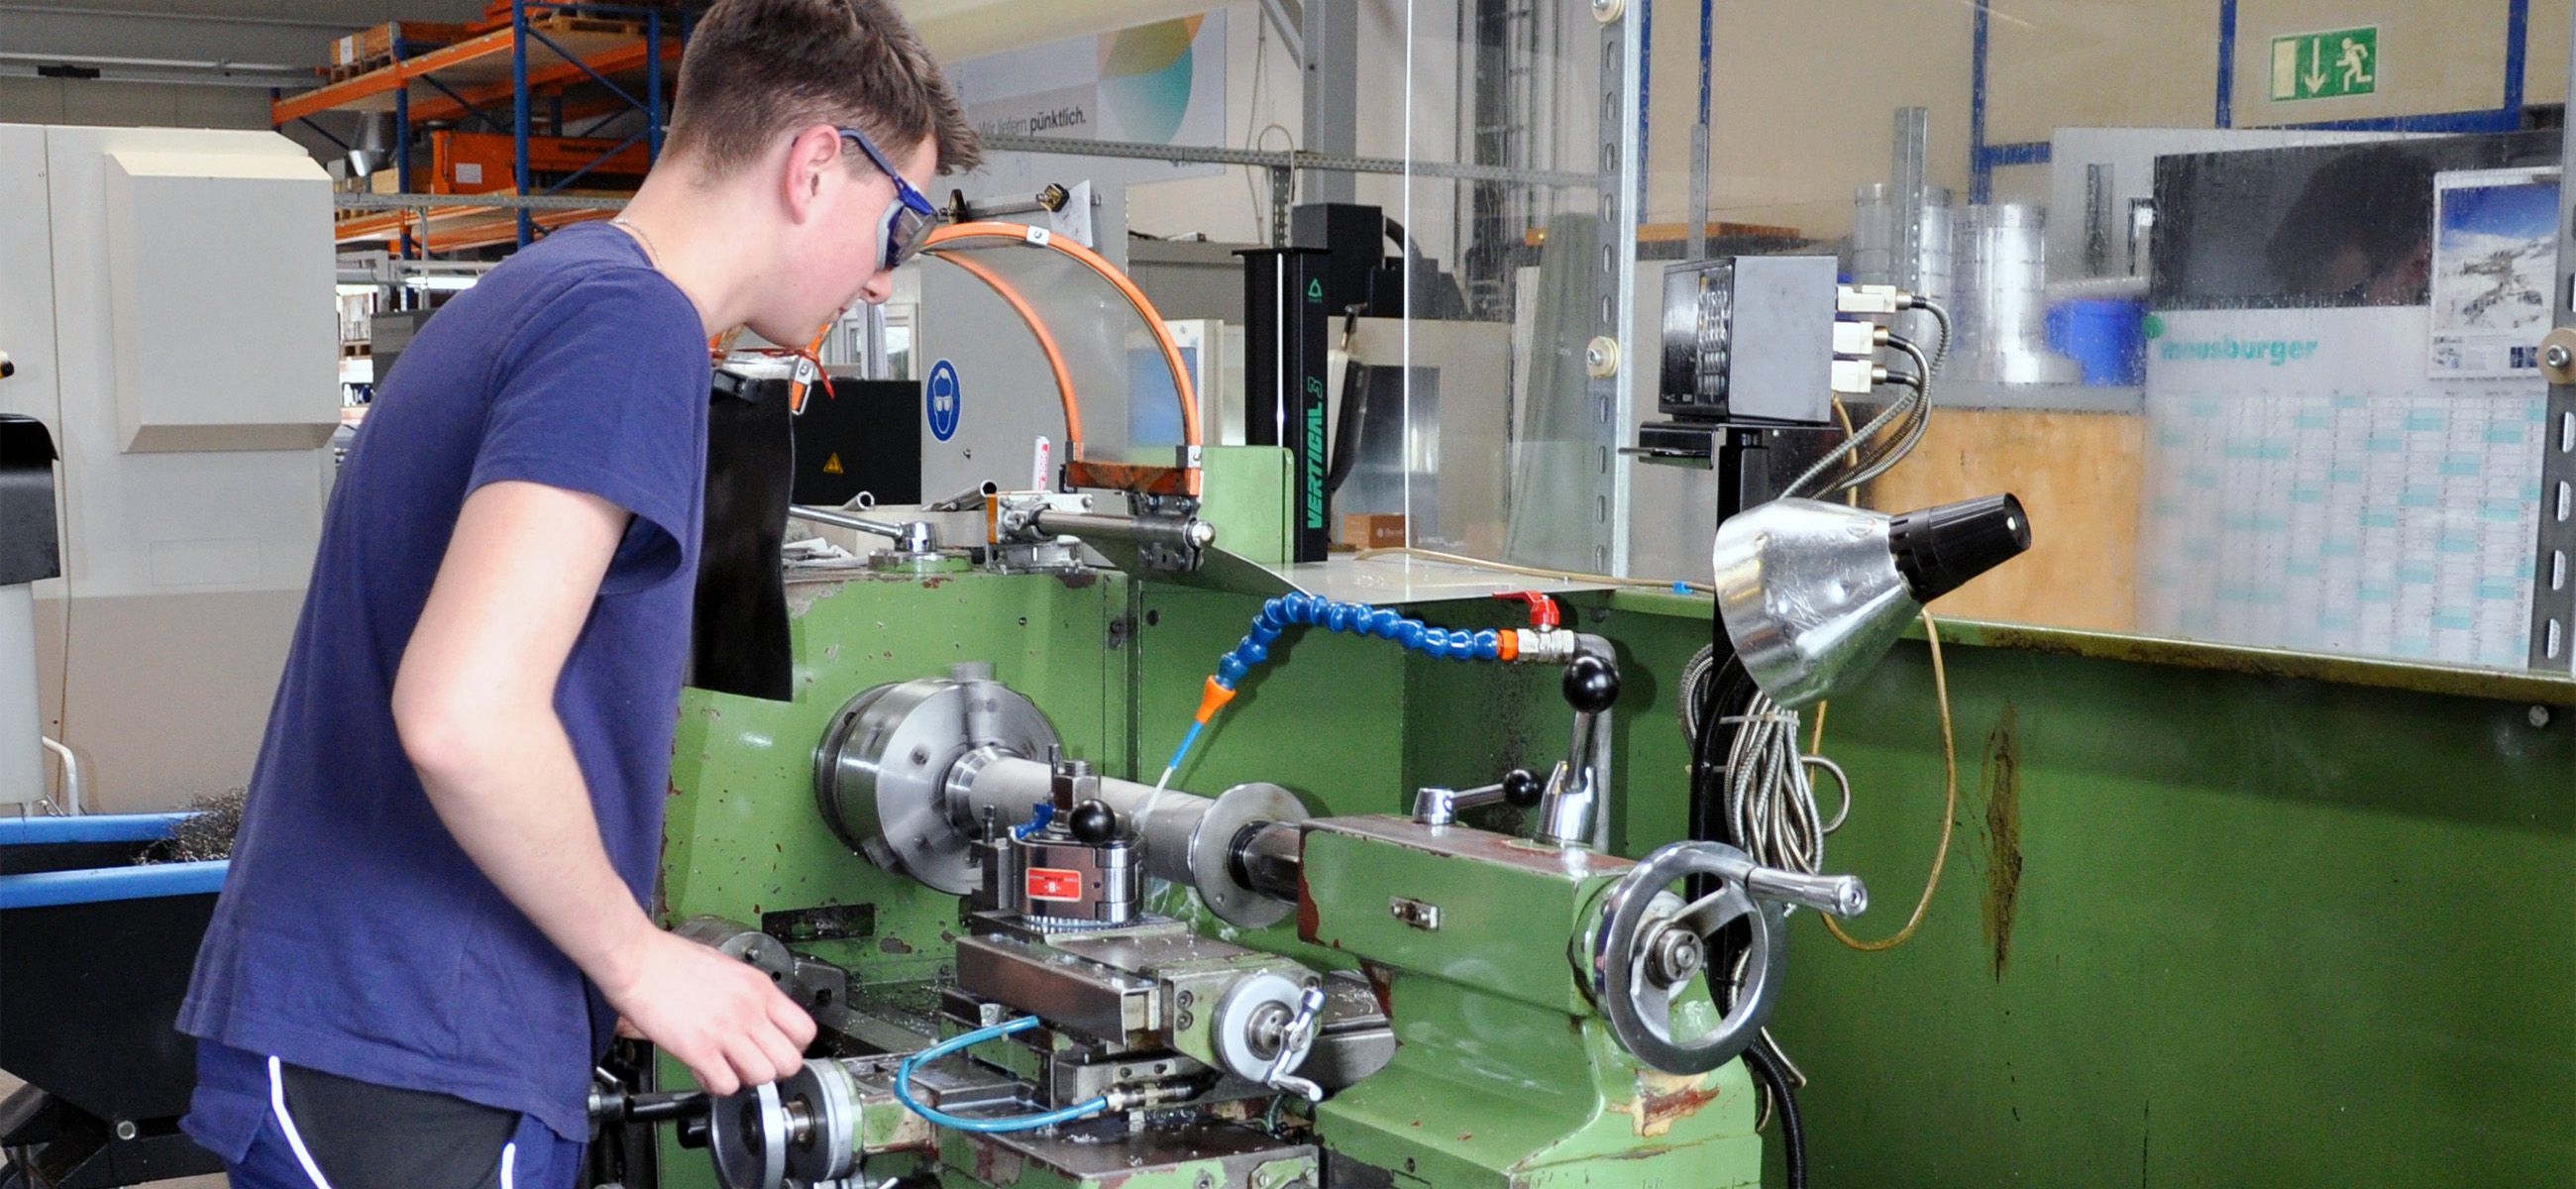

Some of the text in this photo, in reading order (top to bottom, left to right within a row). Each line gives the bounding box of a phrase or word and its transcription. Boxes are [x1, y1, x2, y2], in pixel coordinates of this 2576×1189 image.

[1030, 105, 1087, 137] pünktlich.
[1307, 376, 1324, 529] VERTICAL 3
